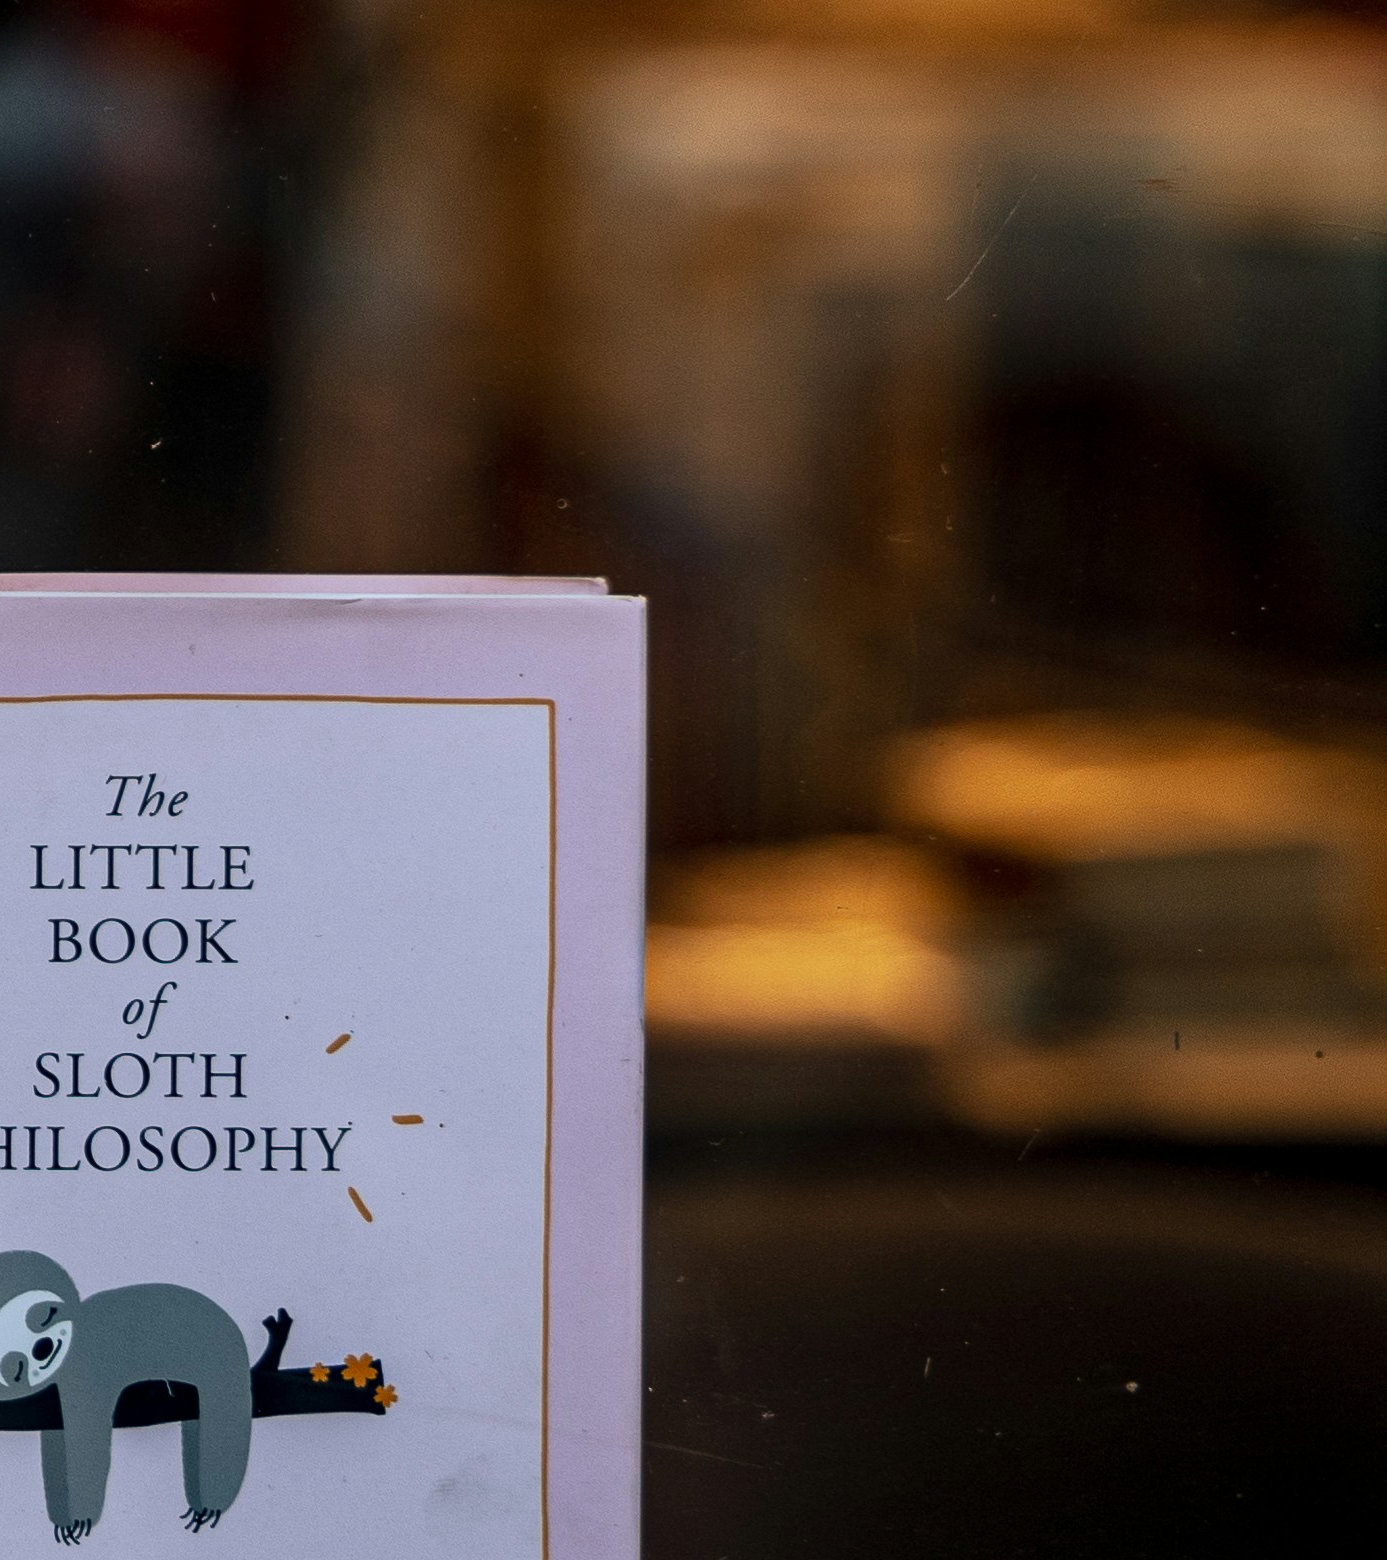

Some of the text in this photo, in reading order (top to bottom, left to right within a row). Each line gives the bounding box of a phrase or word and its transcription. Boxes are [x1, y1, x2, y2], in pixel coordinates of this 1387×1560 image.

[104, 772, 190, 818] The
[28, 843, 256, 891] LITTLE
[47, 916, 240, 965] BOOK
[121, 980, 179, 1041] of
[31, 1051, 248, 1099] SLOTH
